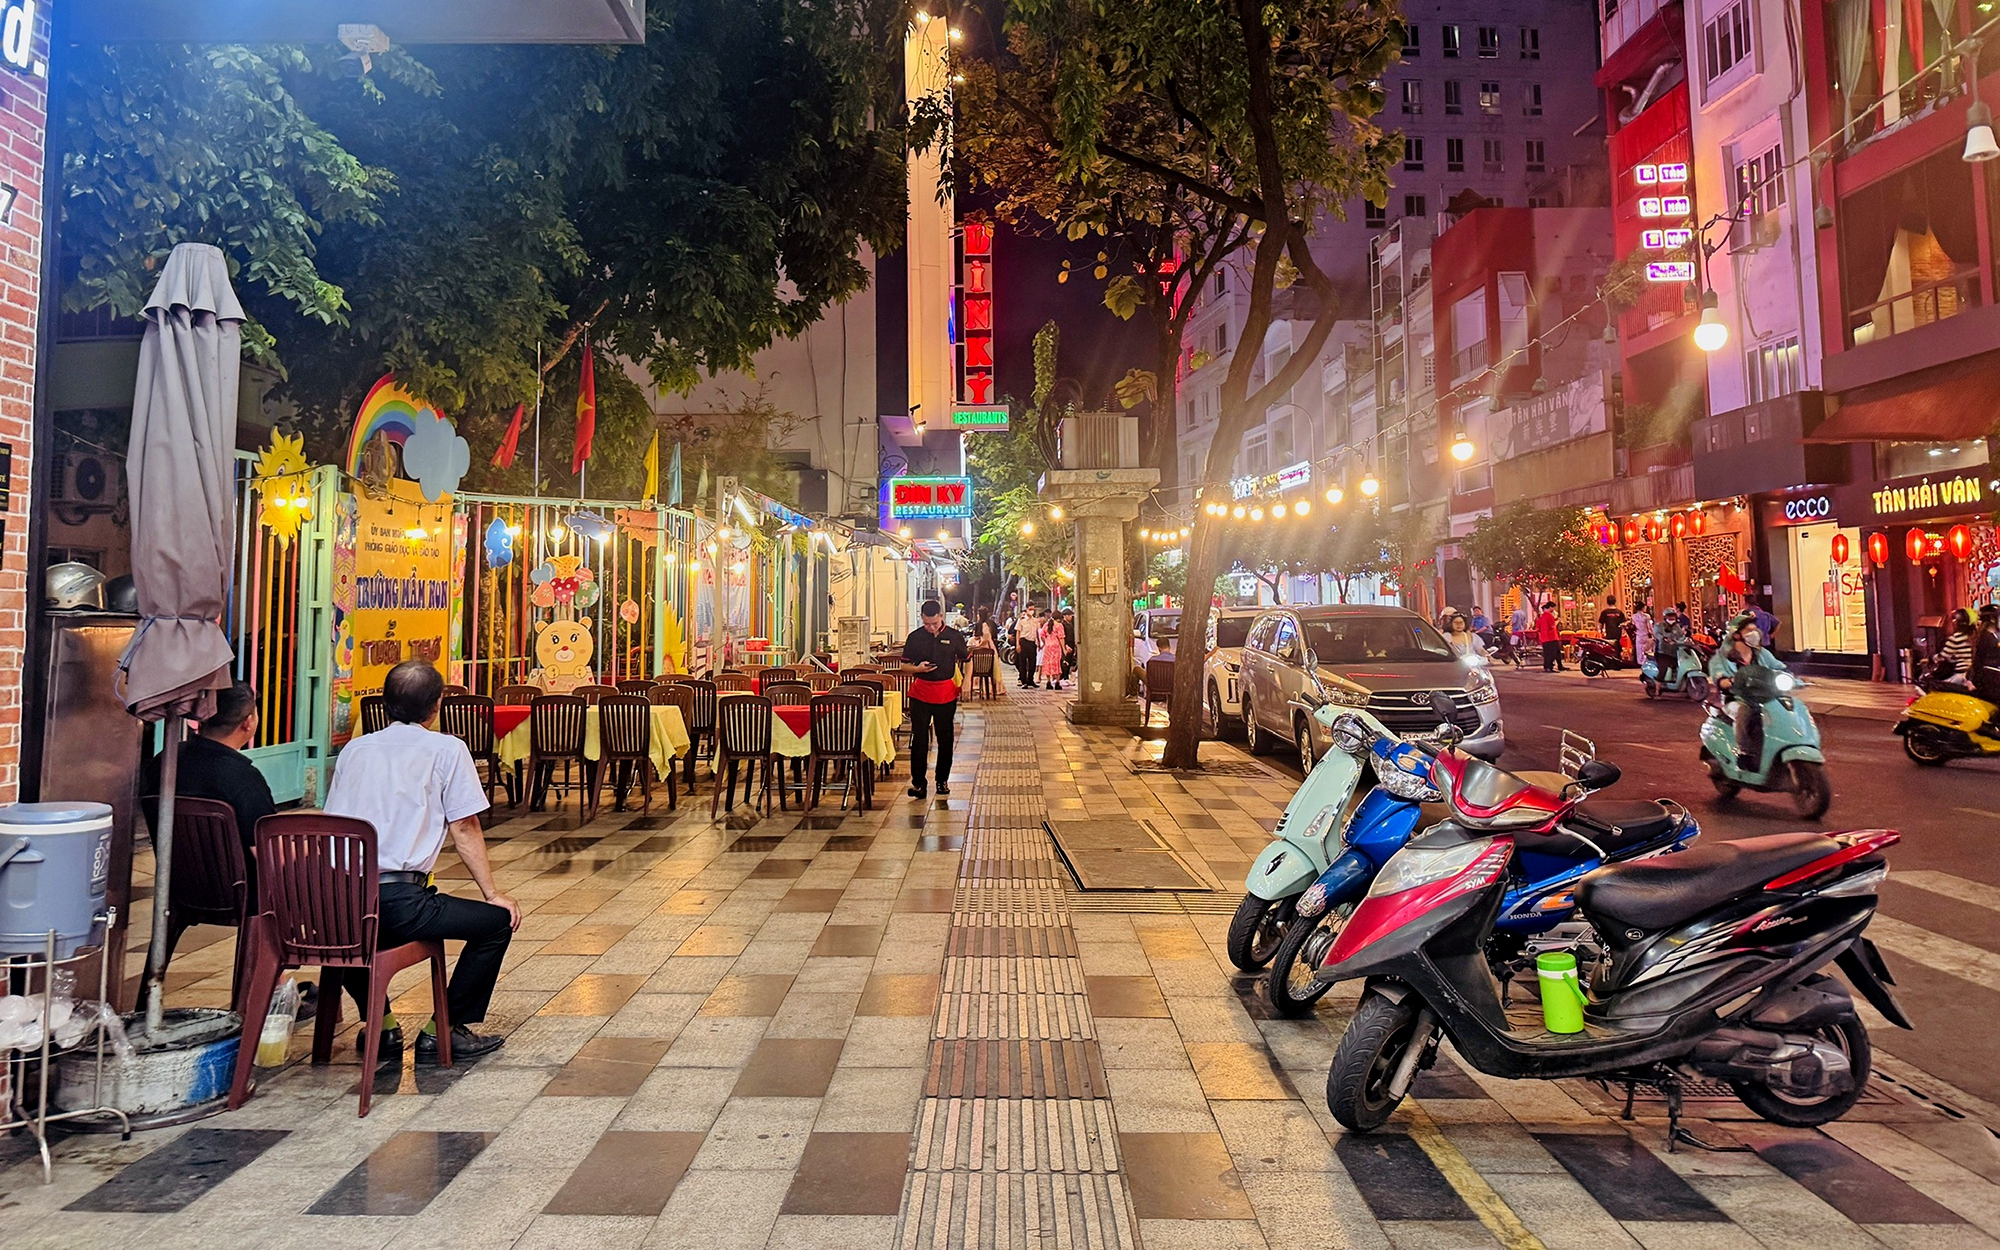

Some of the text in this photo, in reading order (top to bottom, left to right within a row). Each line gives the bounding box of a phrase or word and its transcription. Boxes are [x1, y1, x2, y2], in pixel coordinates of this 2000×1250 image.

[952, 411, 1008, 424] RESTAURANTS
[1872, 475, 1981, 514] TÂN HẢI VÂN
[895, 505, 966, 515] RESTAURANT
[1785, 496, 1830, 520] ecco
[356, 566, 448, 610] TRƯỜNG MẦM NON
[360, 619, 402, 666] TUỔI
[1464, 876, 1486, 890] SYM
[1508, 911, 1542, 920] HONDA
